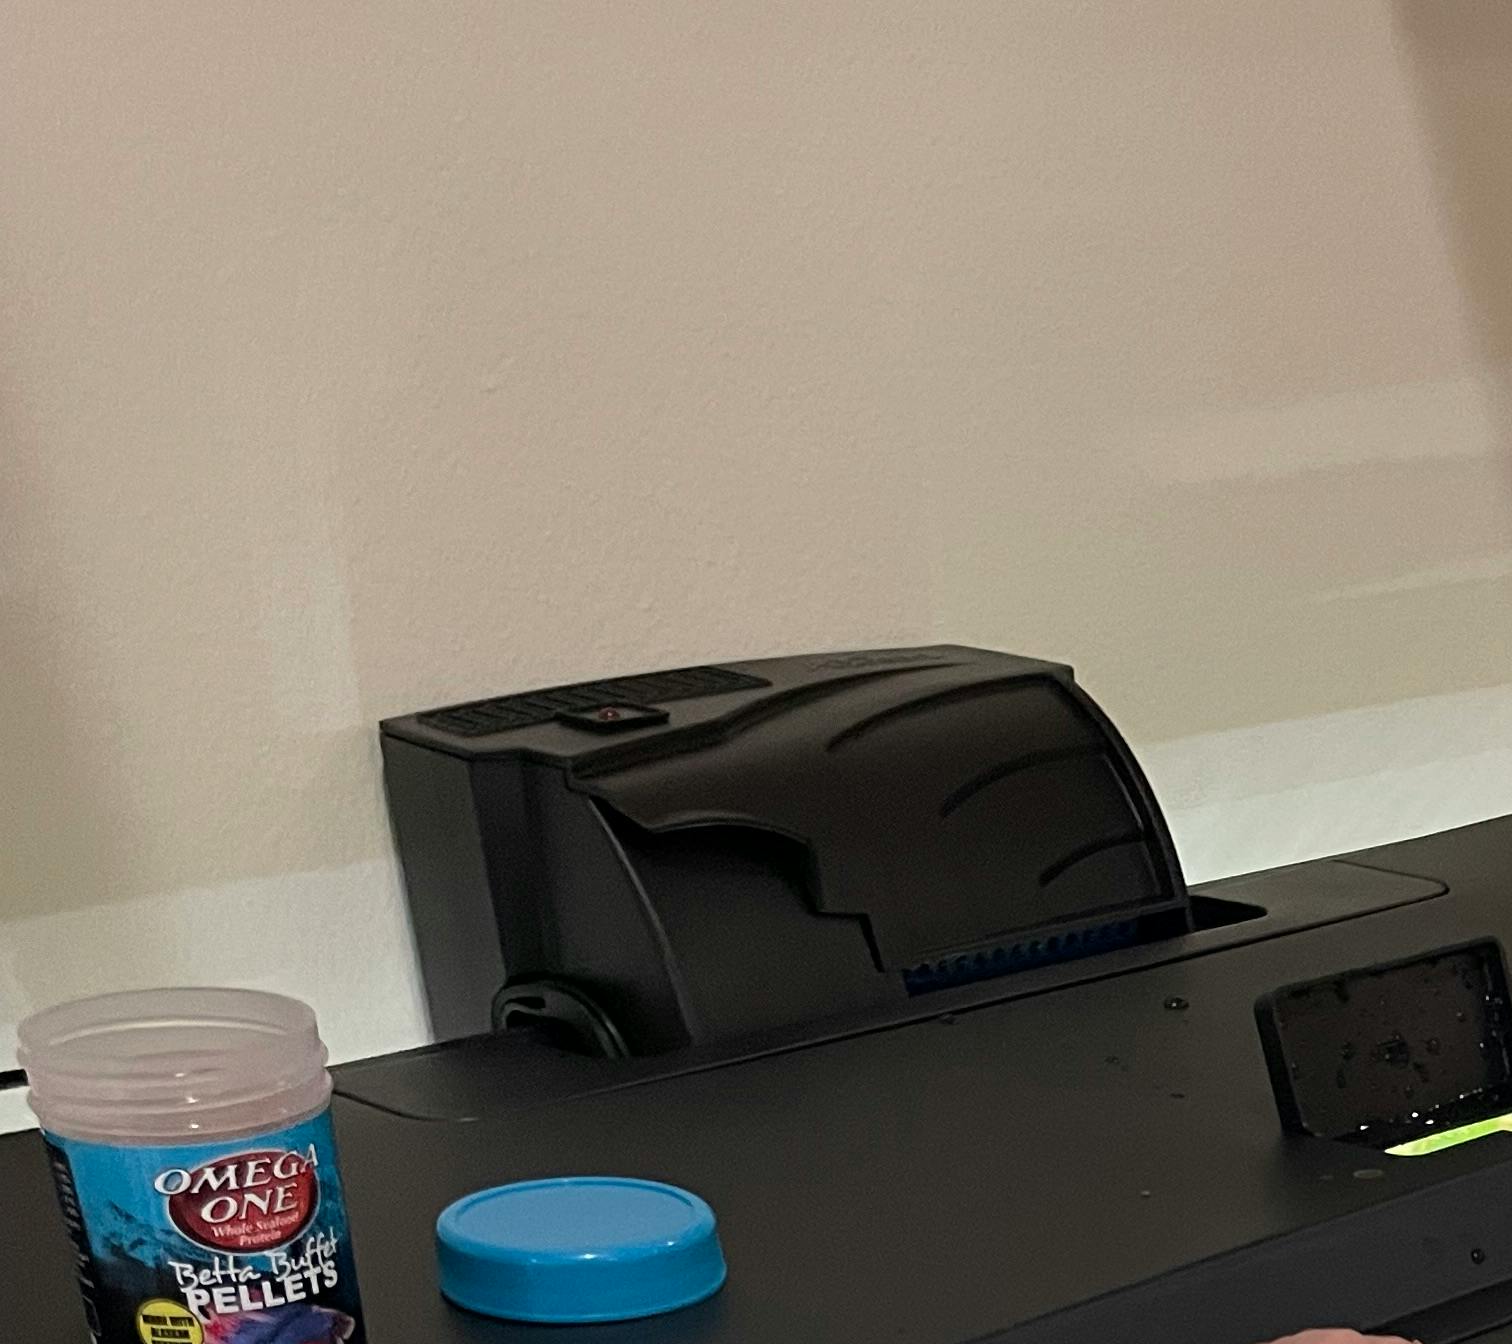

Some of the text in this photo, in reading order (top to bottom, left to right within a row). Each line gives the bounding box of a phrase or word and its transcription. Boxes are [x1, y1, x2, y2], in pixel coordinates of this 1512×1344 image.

[154, 1143, 319, 1195] OMEGA
[201, 1182, 298, 1224] ONE
[210, 1221, 254, 1238] Whole
[167, 1226, 339, 1289] Betta Buffet
[180, 1260, 338, 1324] PELLETS
